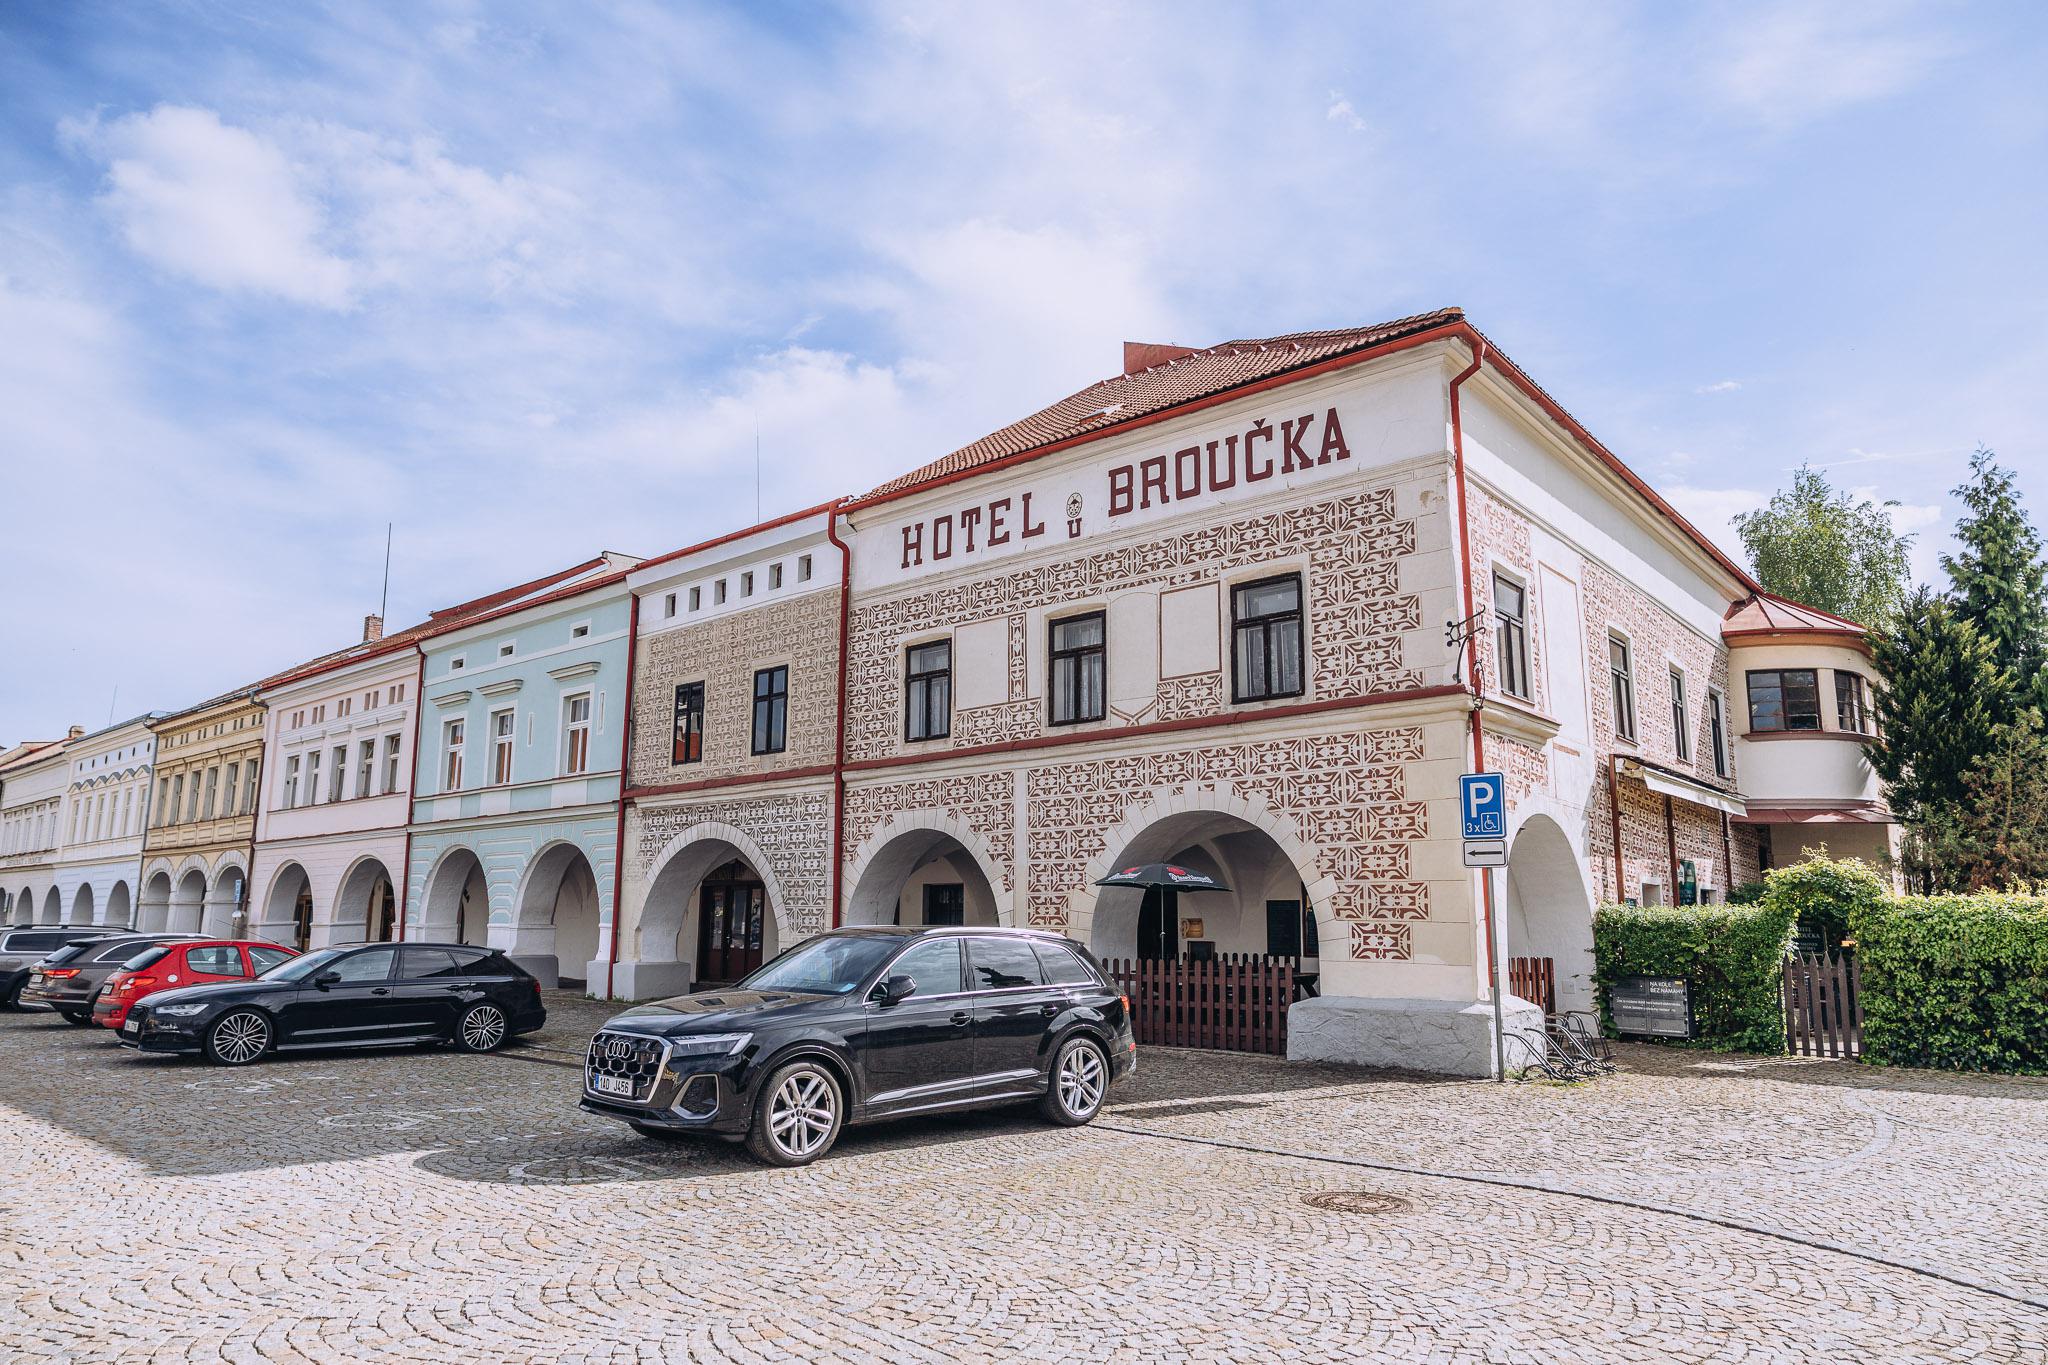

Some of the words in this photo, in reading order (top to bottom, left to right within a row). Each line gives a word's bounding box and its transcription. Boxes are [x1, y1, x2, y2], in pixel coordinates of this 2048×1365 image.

[901, 492, 1045, 570] HOTEL
[1108, 407, 1351, 518] BROUČKA
[1469, 782, 1494, 818] P
